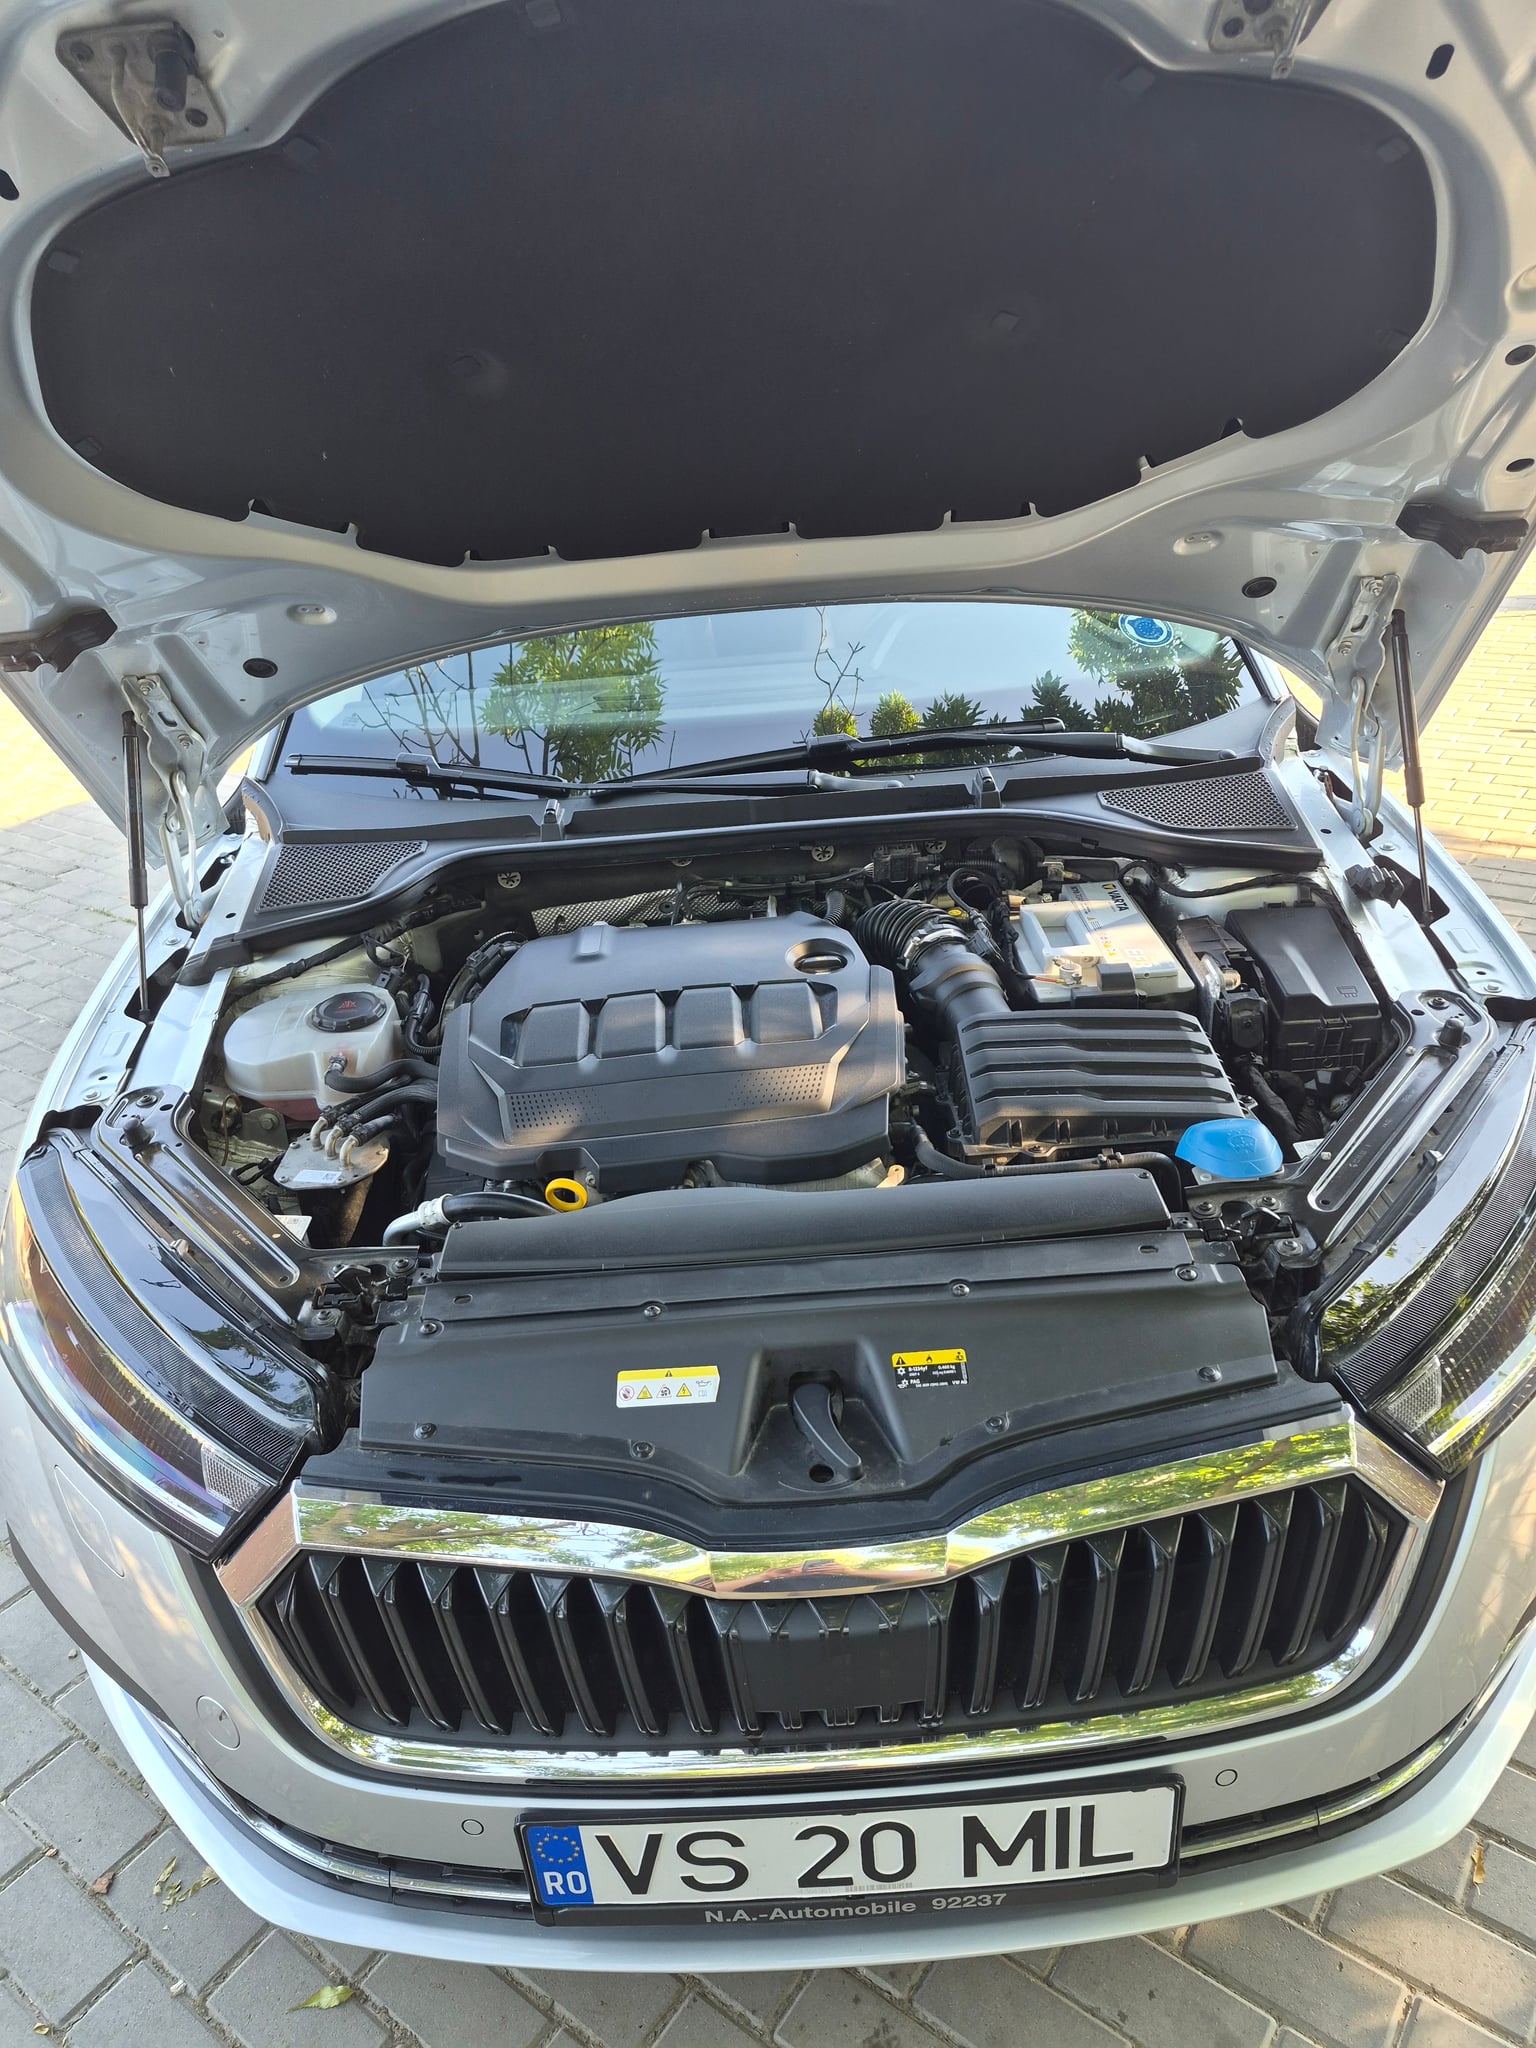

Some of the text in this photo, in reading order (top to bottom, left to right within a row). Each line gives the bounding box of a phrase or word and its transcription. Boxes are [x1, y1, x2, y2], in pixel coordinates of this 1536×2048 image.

[1108, 890, 1129, 912] VARTA
[594, 1804, 1134, 1895] VS 20 MIL
[543, 1870, 587, 1896] RO
[704, 1892, 1007, 1923] N.A.-Automobile 92237
